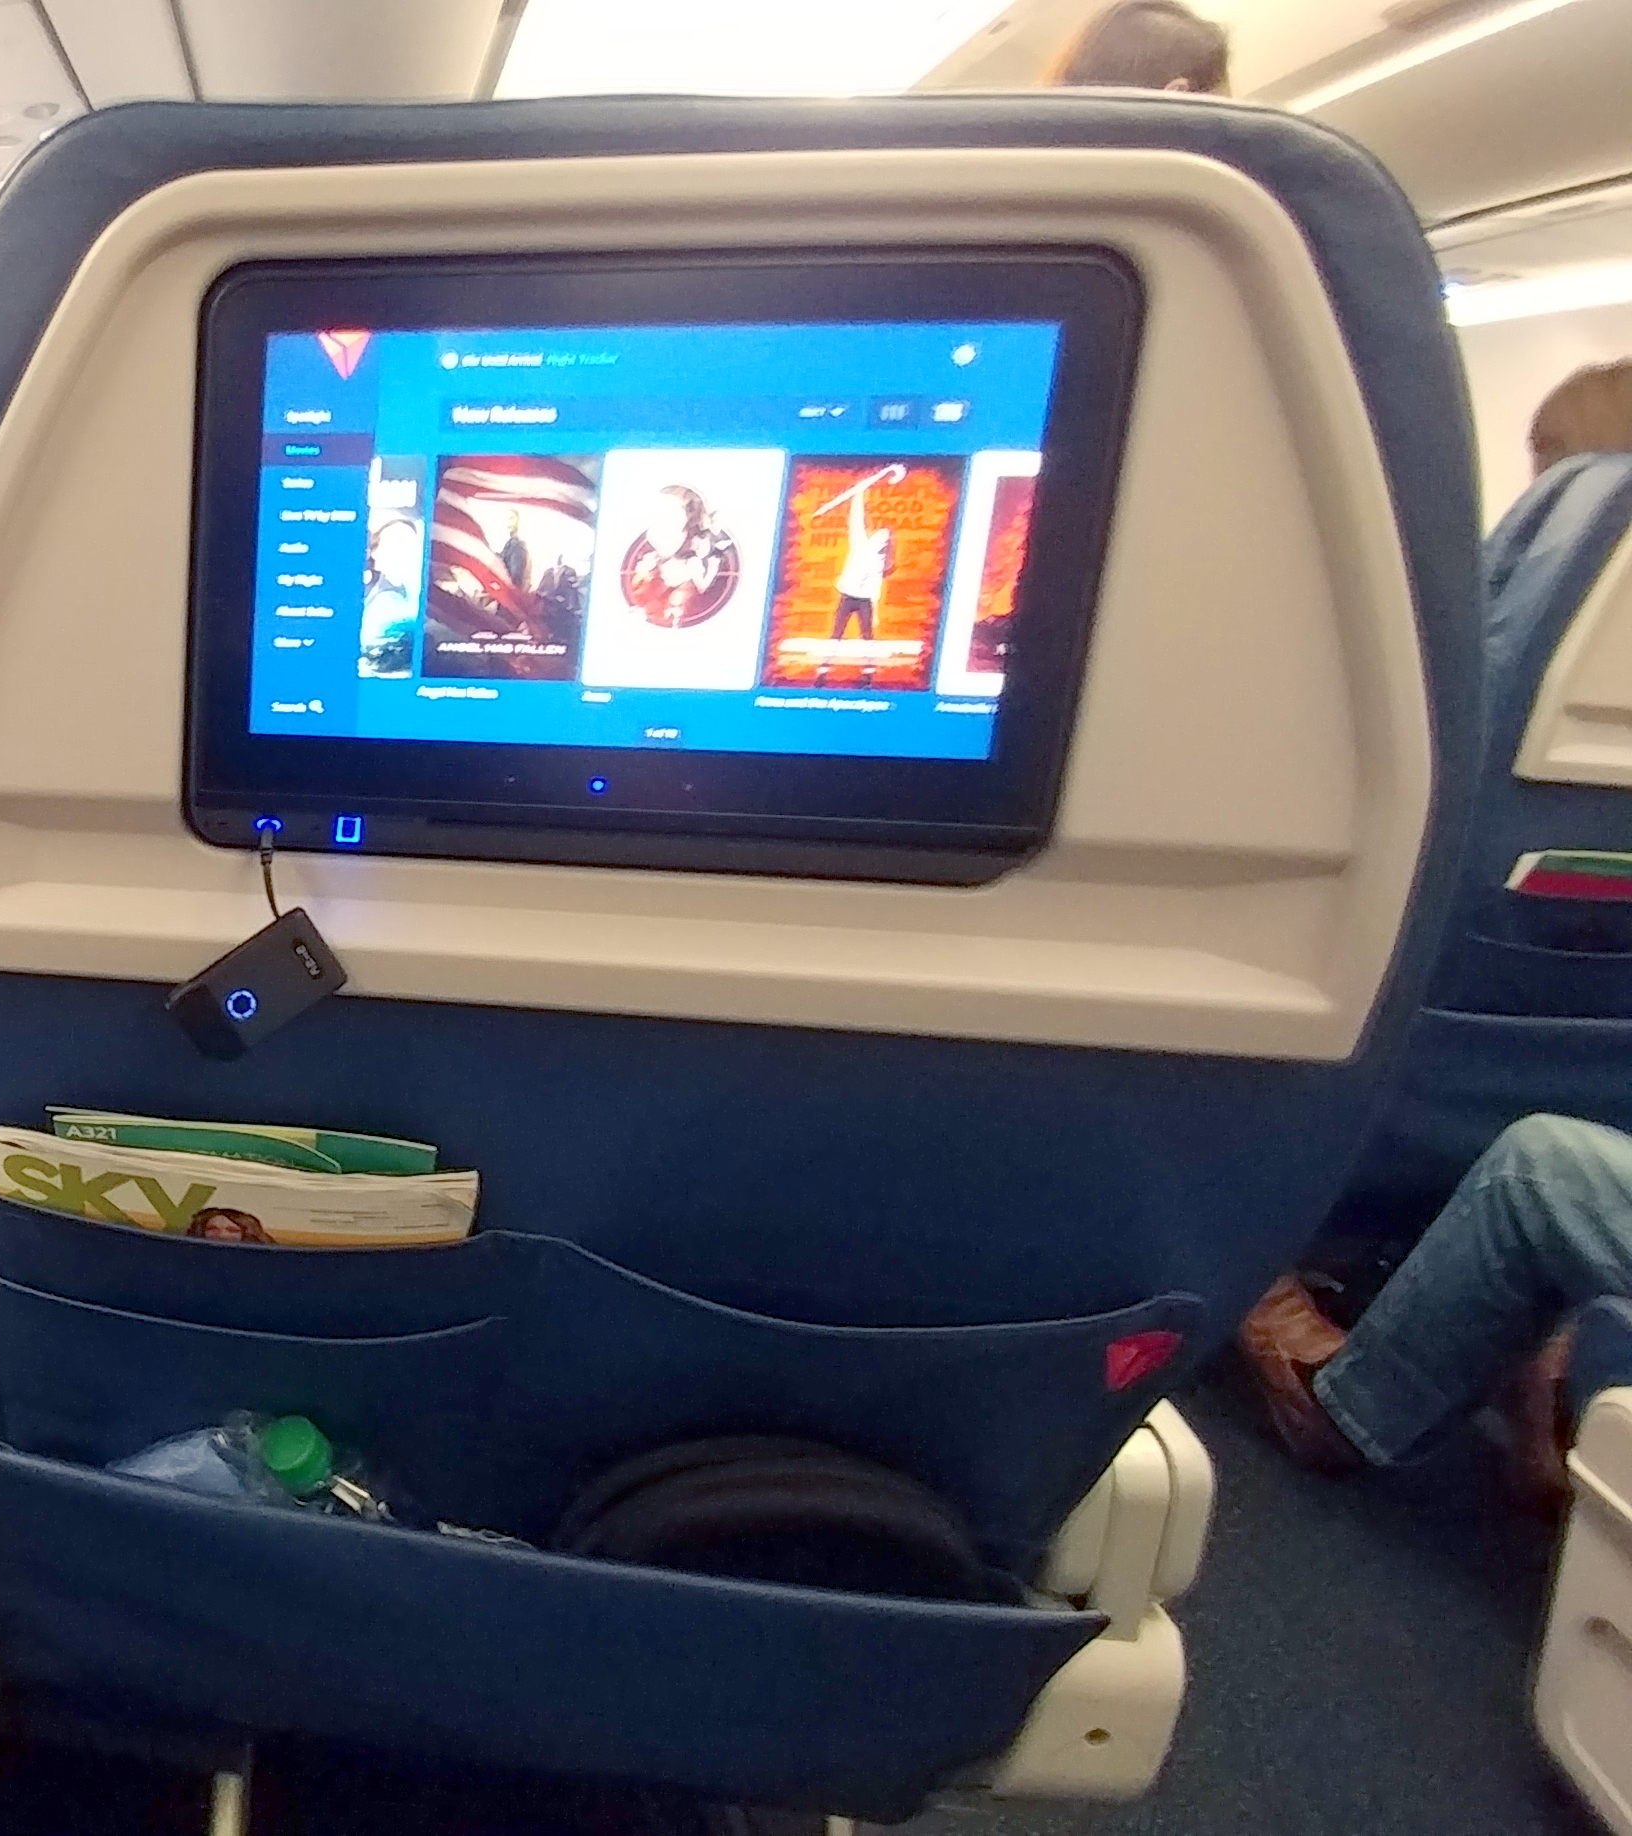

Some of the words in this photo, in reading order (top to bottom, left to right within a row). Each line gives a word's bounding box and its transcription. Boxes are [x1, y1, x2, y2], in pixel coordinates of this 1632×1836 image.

[452, 405, 489, 424] New
[490, 405, 558, 424] Releases
[285, 443, 321, 457] Movies
[436, 642, 484, 655] ANGEL
[484, 643, 513, 655] HAS
[515, 643, 568, 656] FALLEN
[270, 701, 307, 713] Search
[66, 1123, 117, 1142] A321
[1, 1153, 218, 1236] SKY
